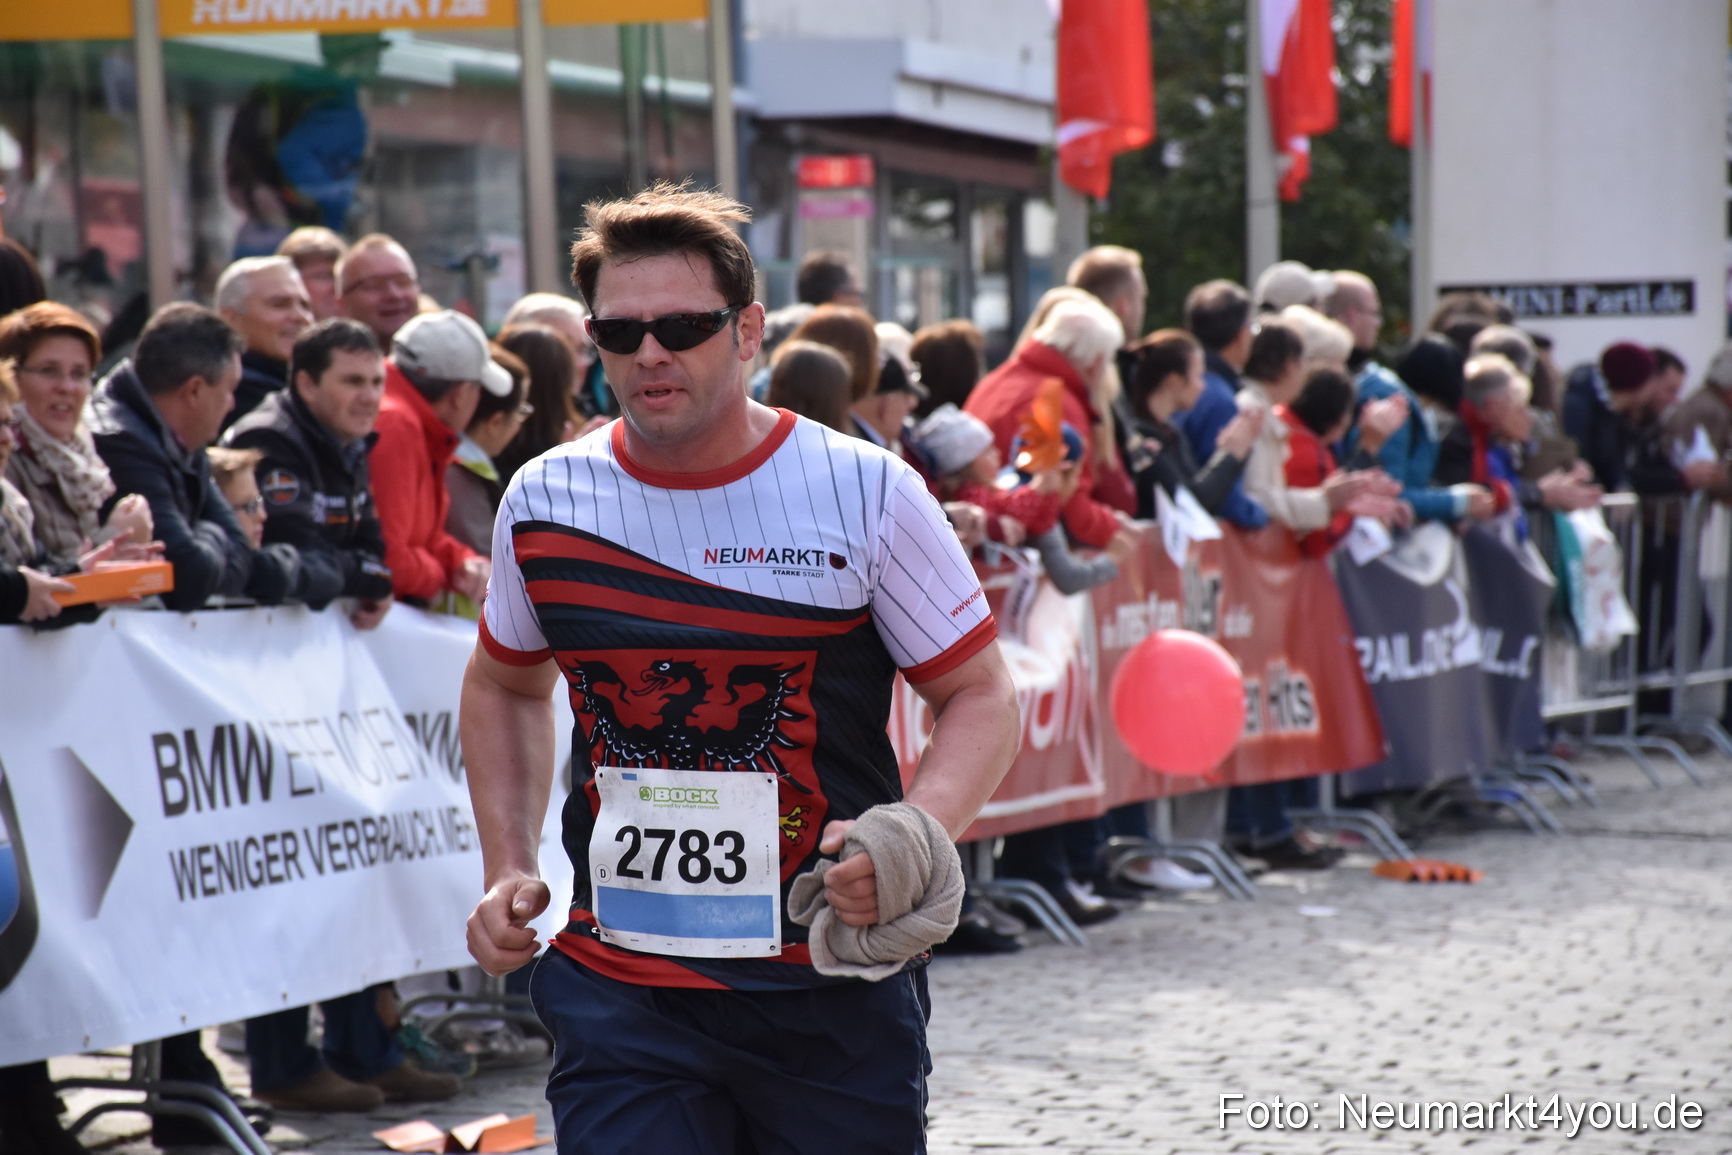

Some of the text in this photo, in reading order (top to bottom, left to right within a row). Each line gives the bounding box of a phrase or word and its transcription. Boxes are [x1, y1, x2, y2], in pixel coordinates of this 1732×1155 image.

[704, 547, 824, 566] NEUMARKT
[772, 569, 801, 577] STARKE
[152, 721, 273, 818] BMW
[653, 786, 719, 804] BOCK
[614, 825, 747, 885] 2783
[169, 831, 305, 902] WENIGER
[600, 868, 607, 879] D
